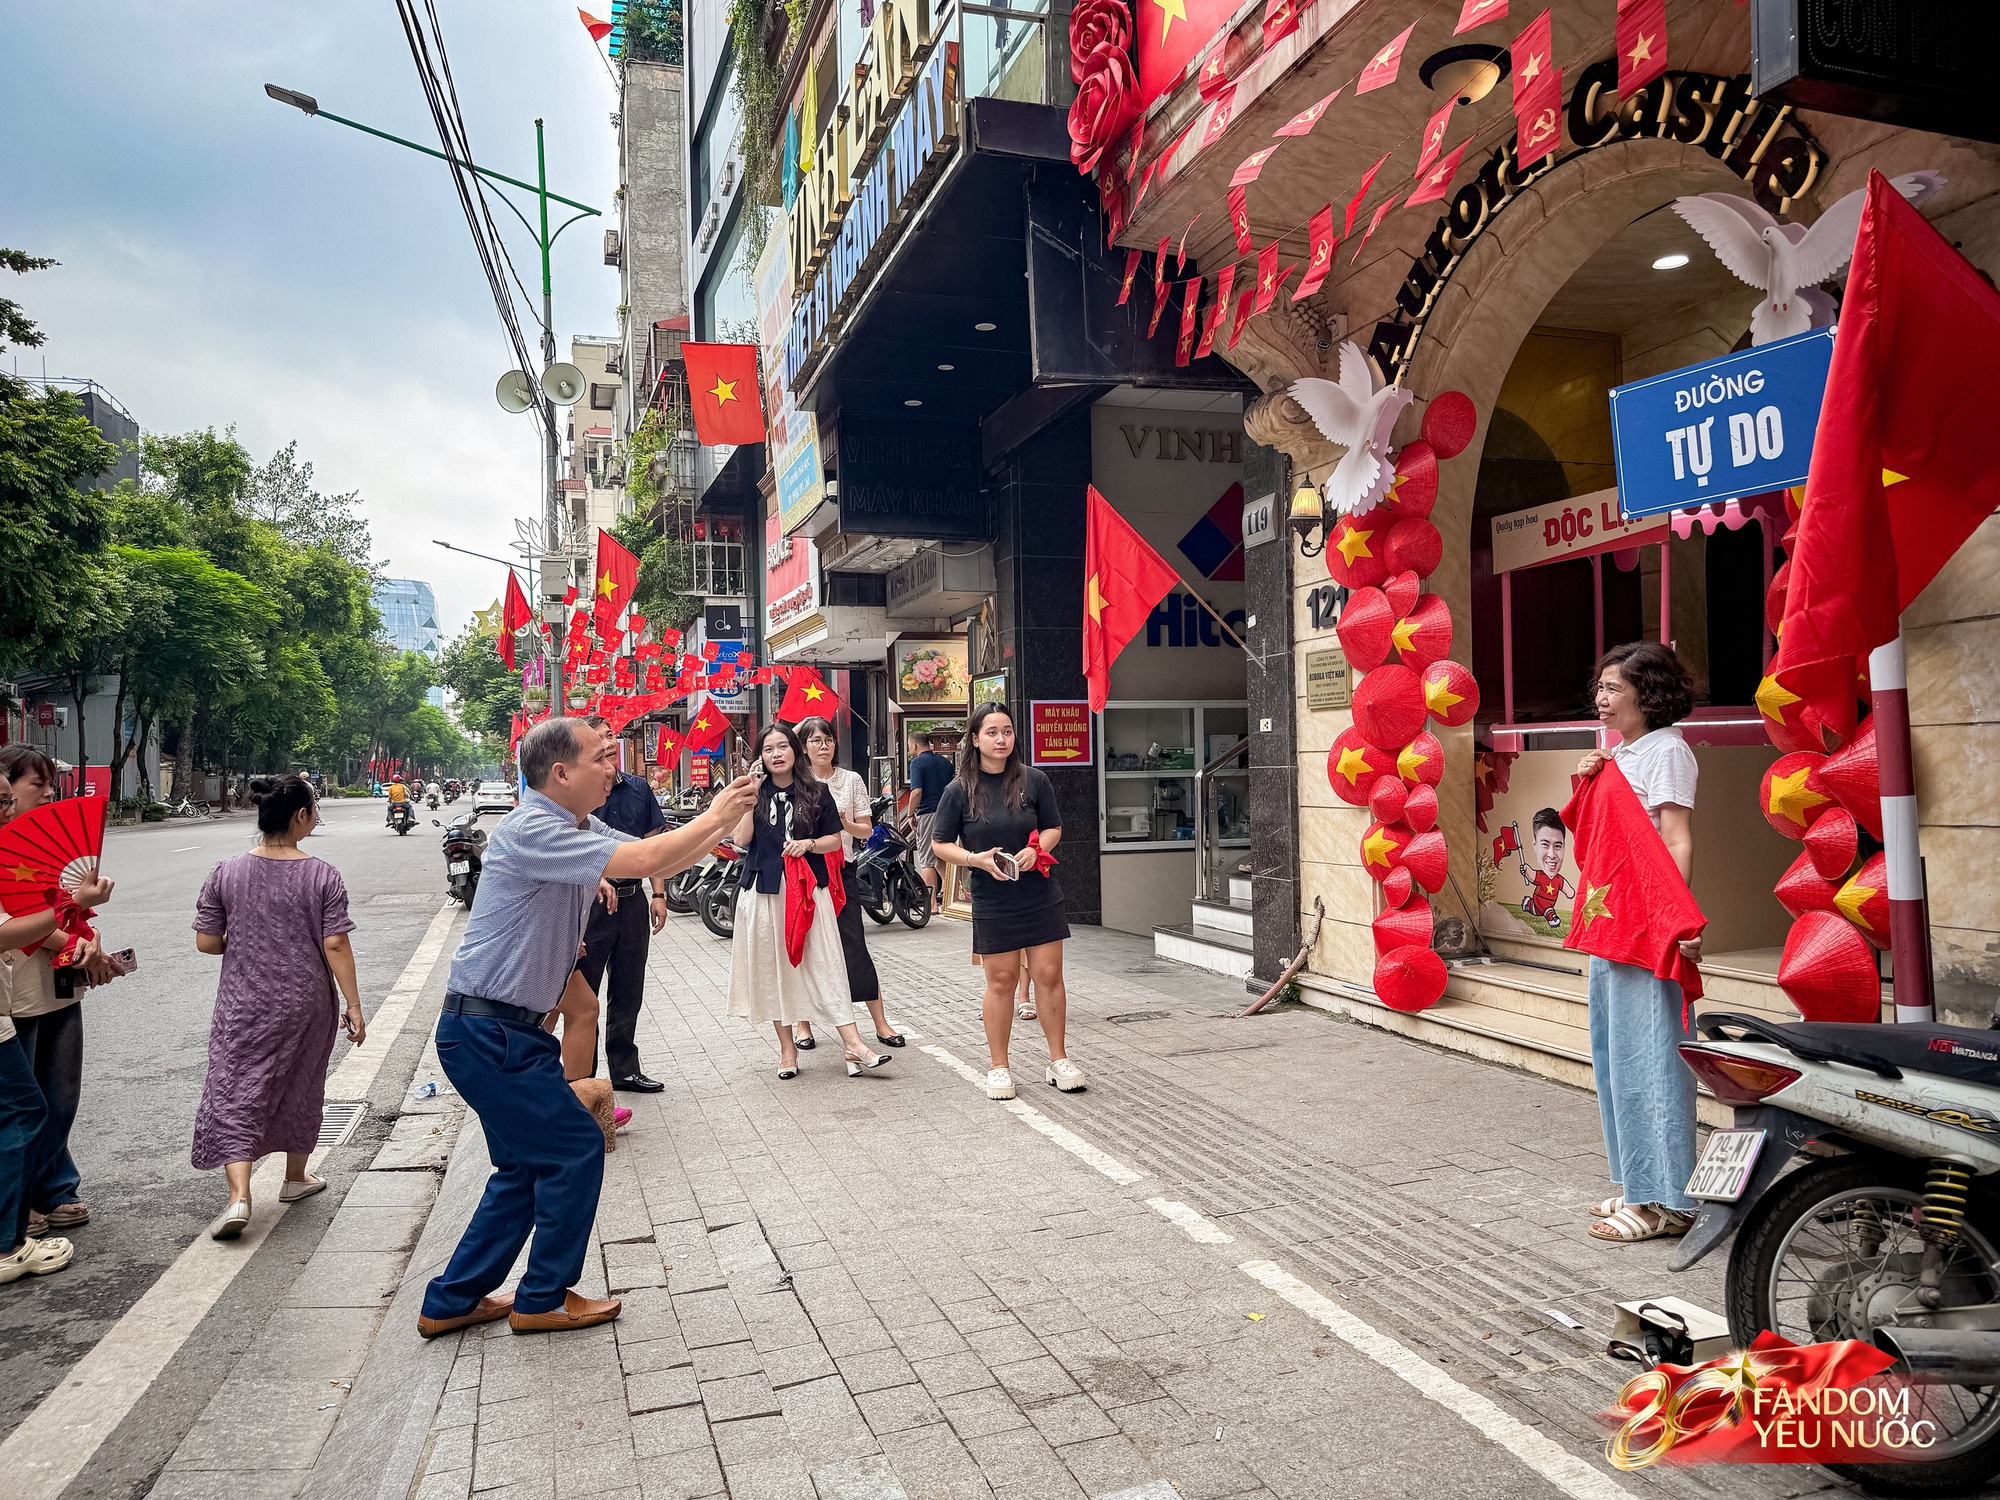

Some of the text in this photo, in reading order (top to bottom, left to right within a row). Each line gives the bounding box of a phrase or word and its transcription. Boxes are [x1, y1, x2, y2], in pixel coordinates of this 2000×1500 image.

[1567, 58, 1828, 215] Castle
[783, 290, 814, 392] THIẾT
[894, 43, 953, 208] MAY
[1674, 369, 1765, 413] ĐƯỜNG
[843, 434, 910, 466] VINH
[1118, 424, 1243, 464] VINH
[1665, 405, 1784, 487] TỰ DO
[848, 481, 904, 513] MÁY
[909, 485, 976, 517] KHÂU
[1246, 506, 1268, 537] 119
[1542, 507, 1594, 548] ĐỘC
[1306, 585, 1349, 629] 121
[1045, 706, 1080, 718] MÁY KHÂU
[1855, 1090, 1930, 1117] WAVE
[1691, 1165, 1746, 1195] 607.70
